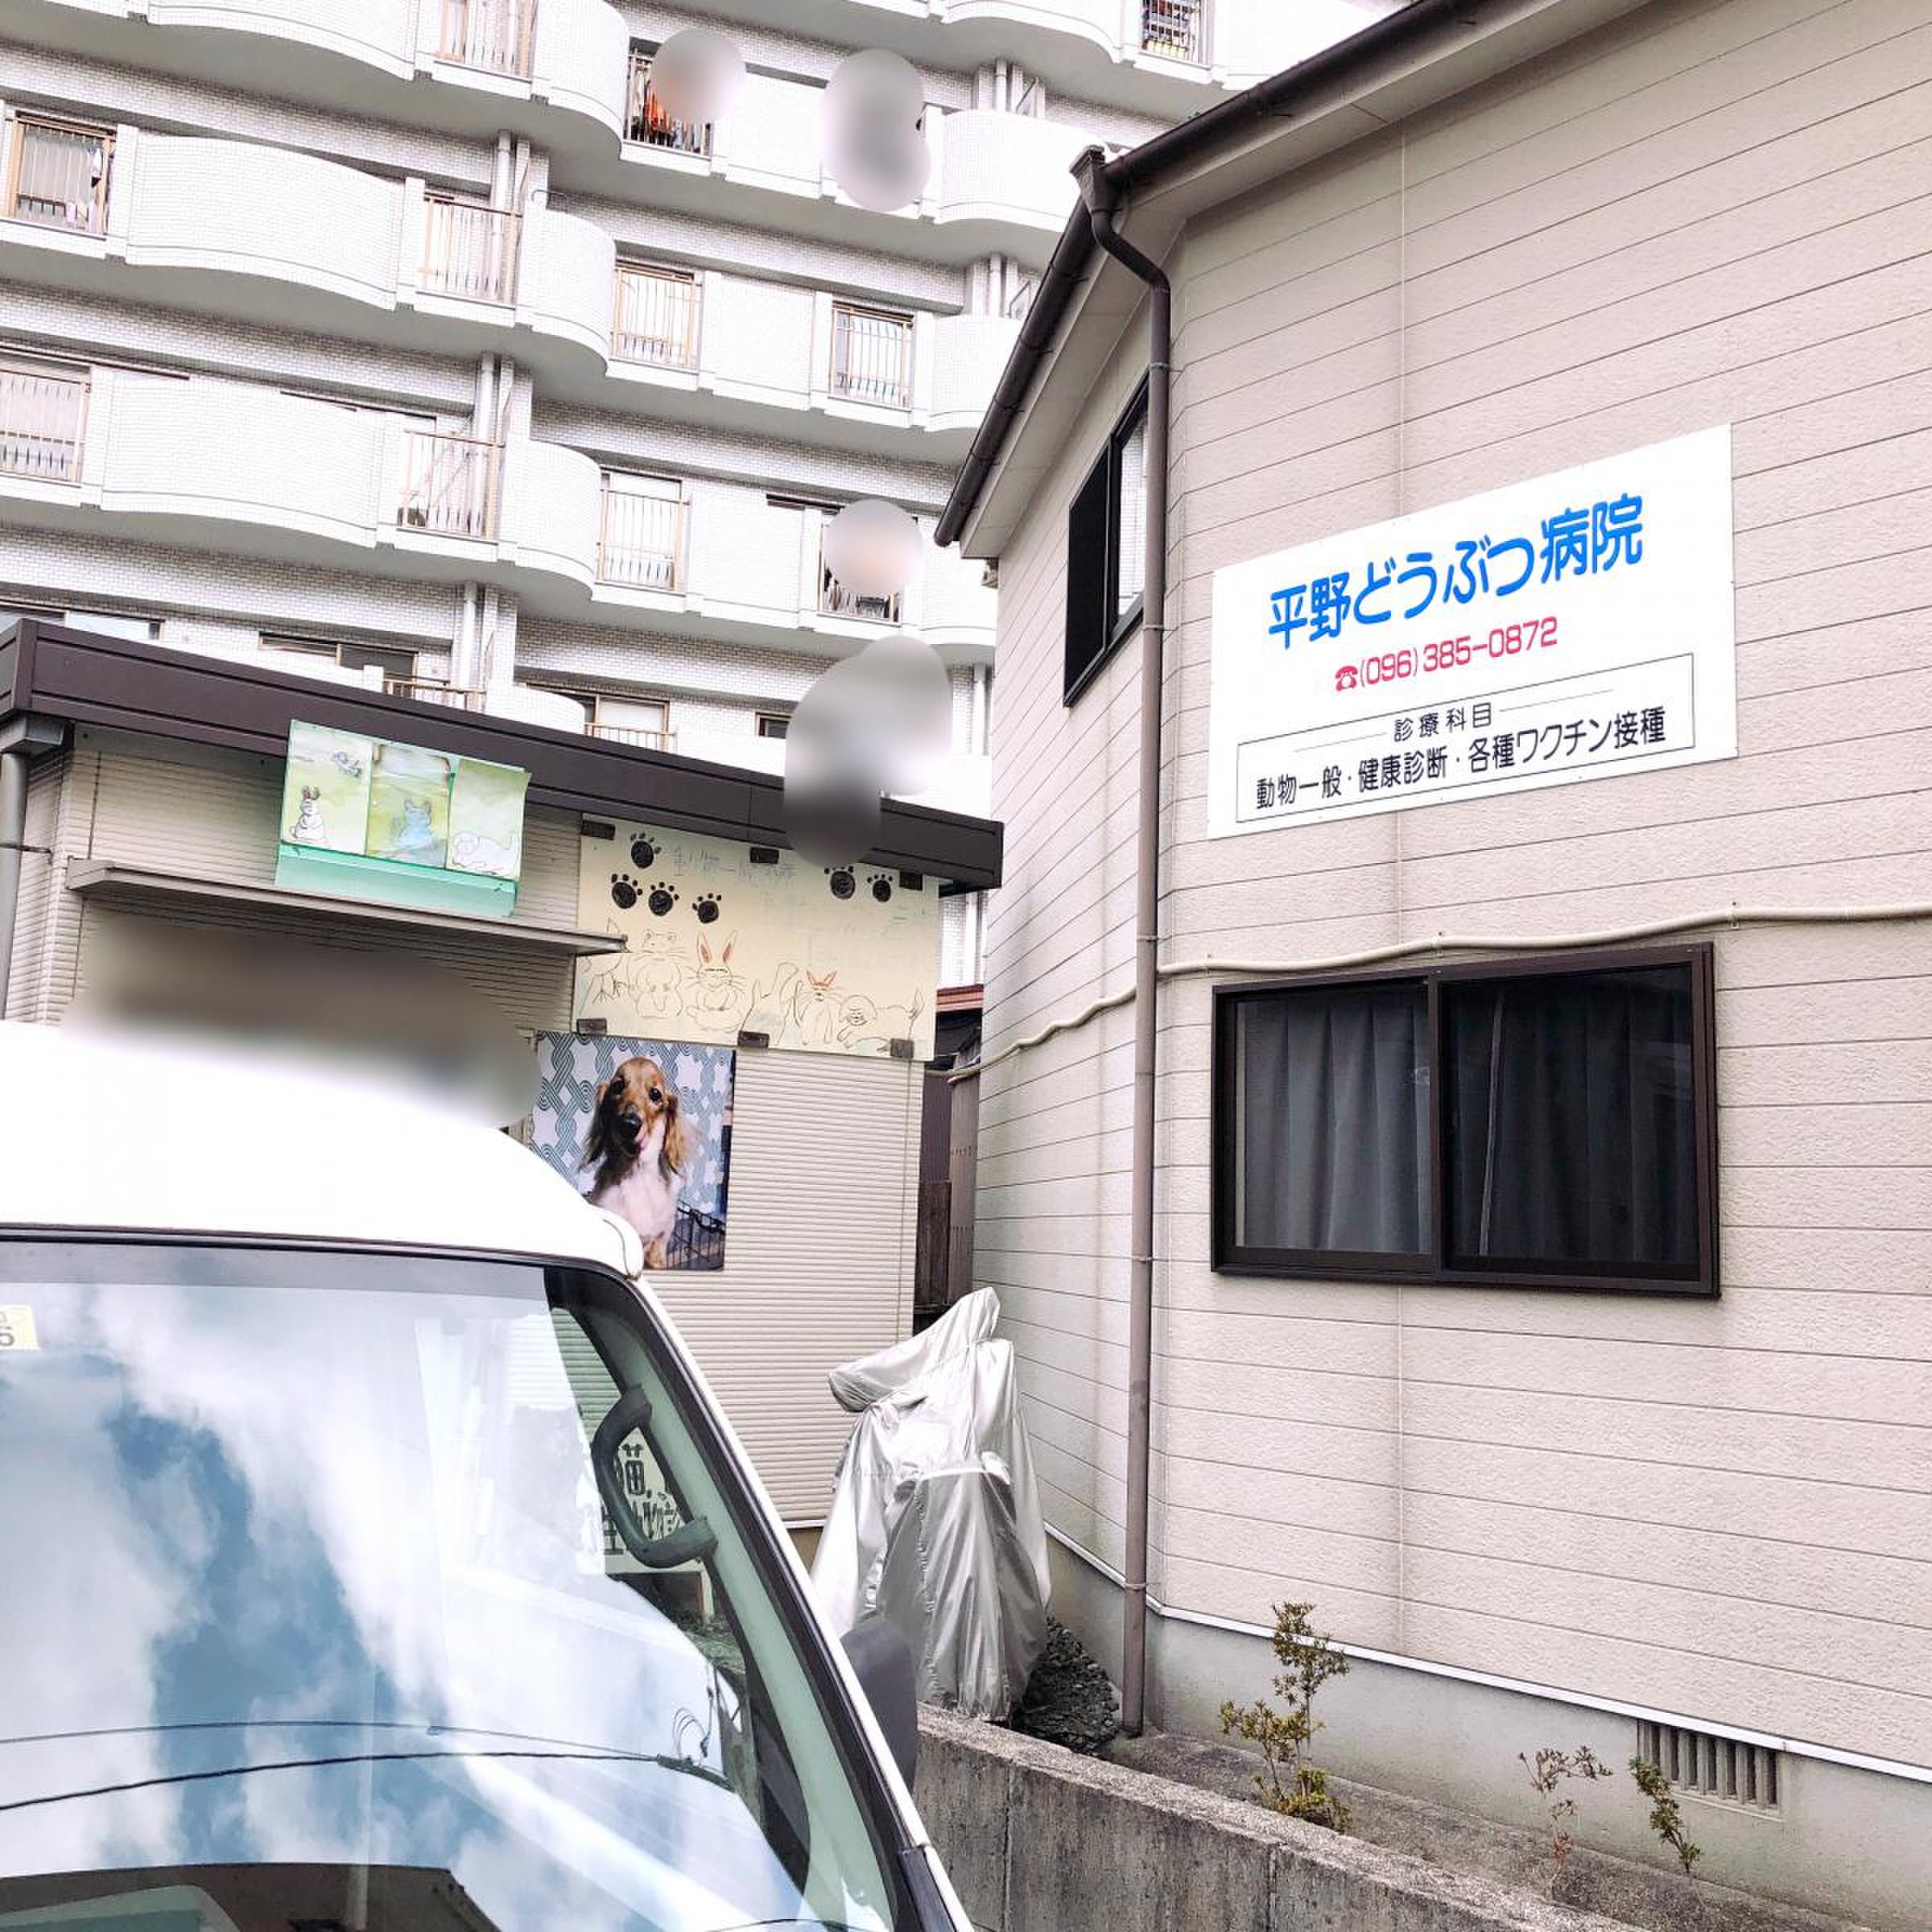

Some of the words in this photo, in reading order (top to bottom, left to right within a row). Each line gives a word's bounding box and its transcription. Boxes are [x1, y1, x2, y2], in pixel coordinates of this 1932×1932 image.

[1268, 492, 1644, 650] 平野どうぶつ病院
[1393, 702, 1492, 742] 診療科目
